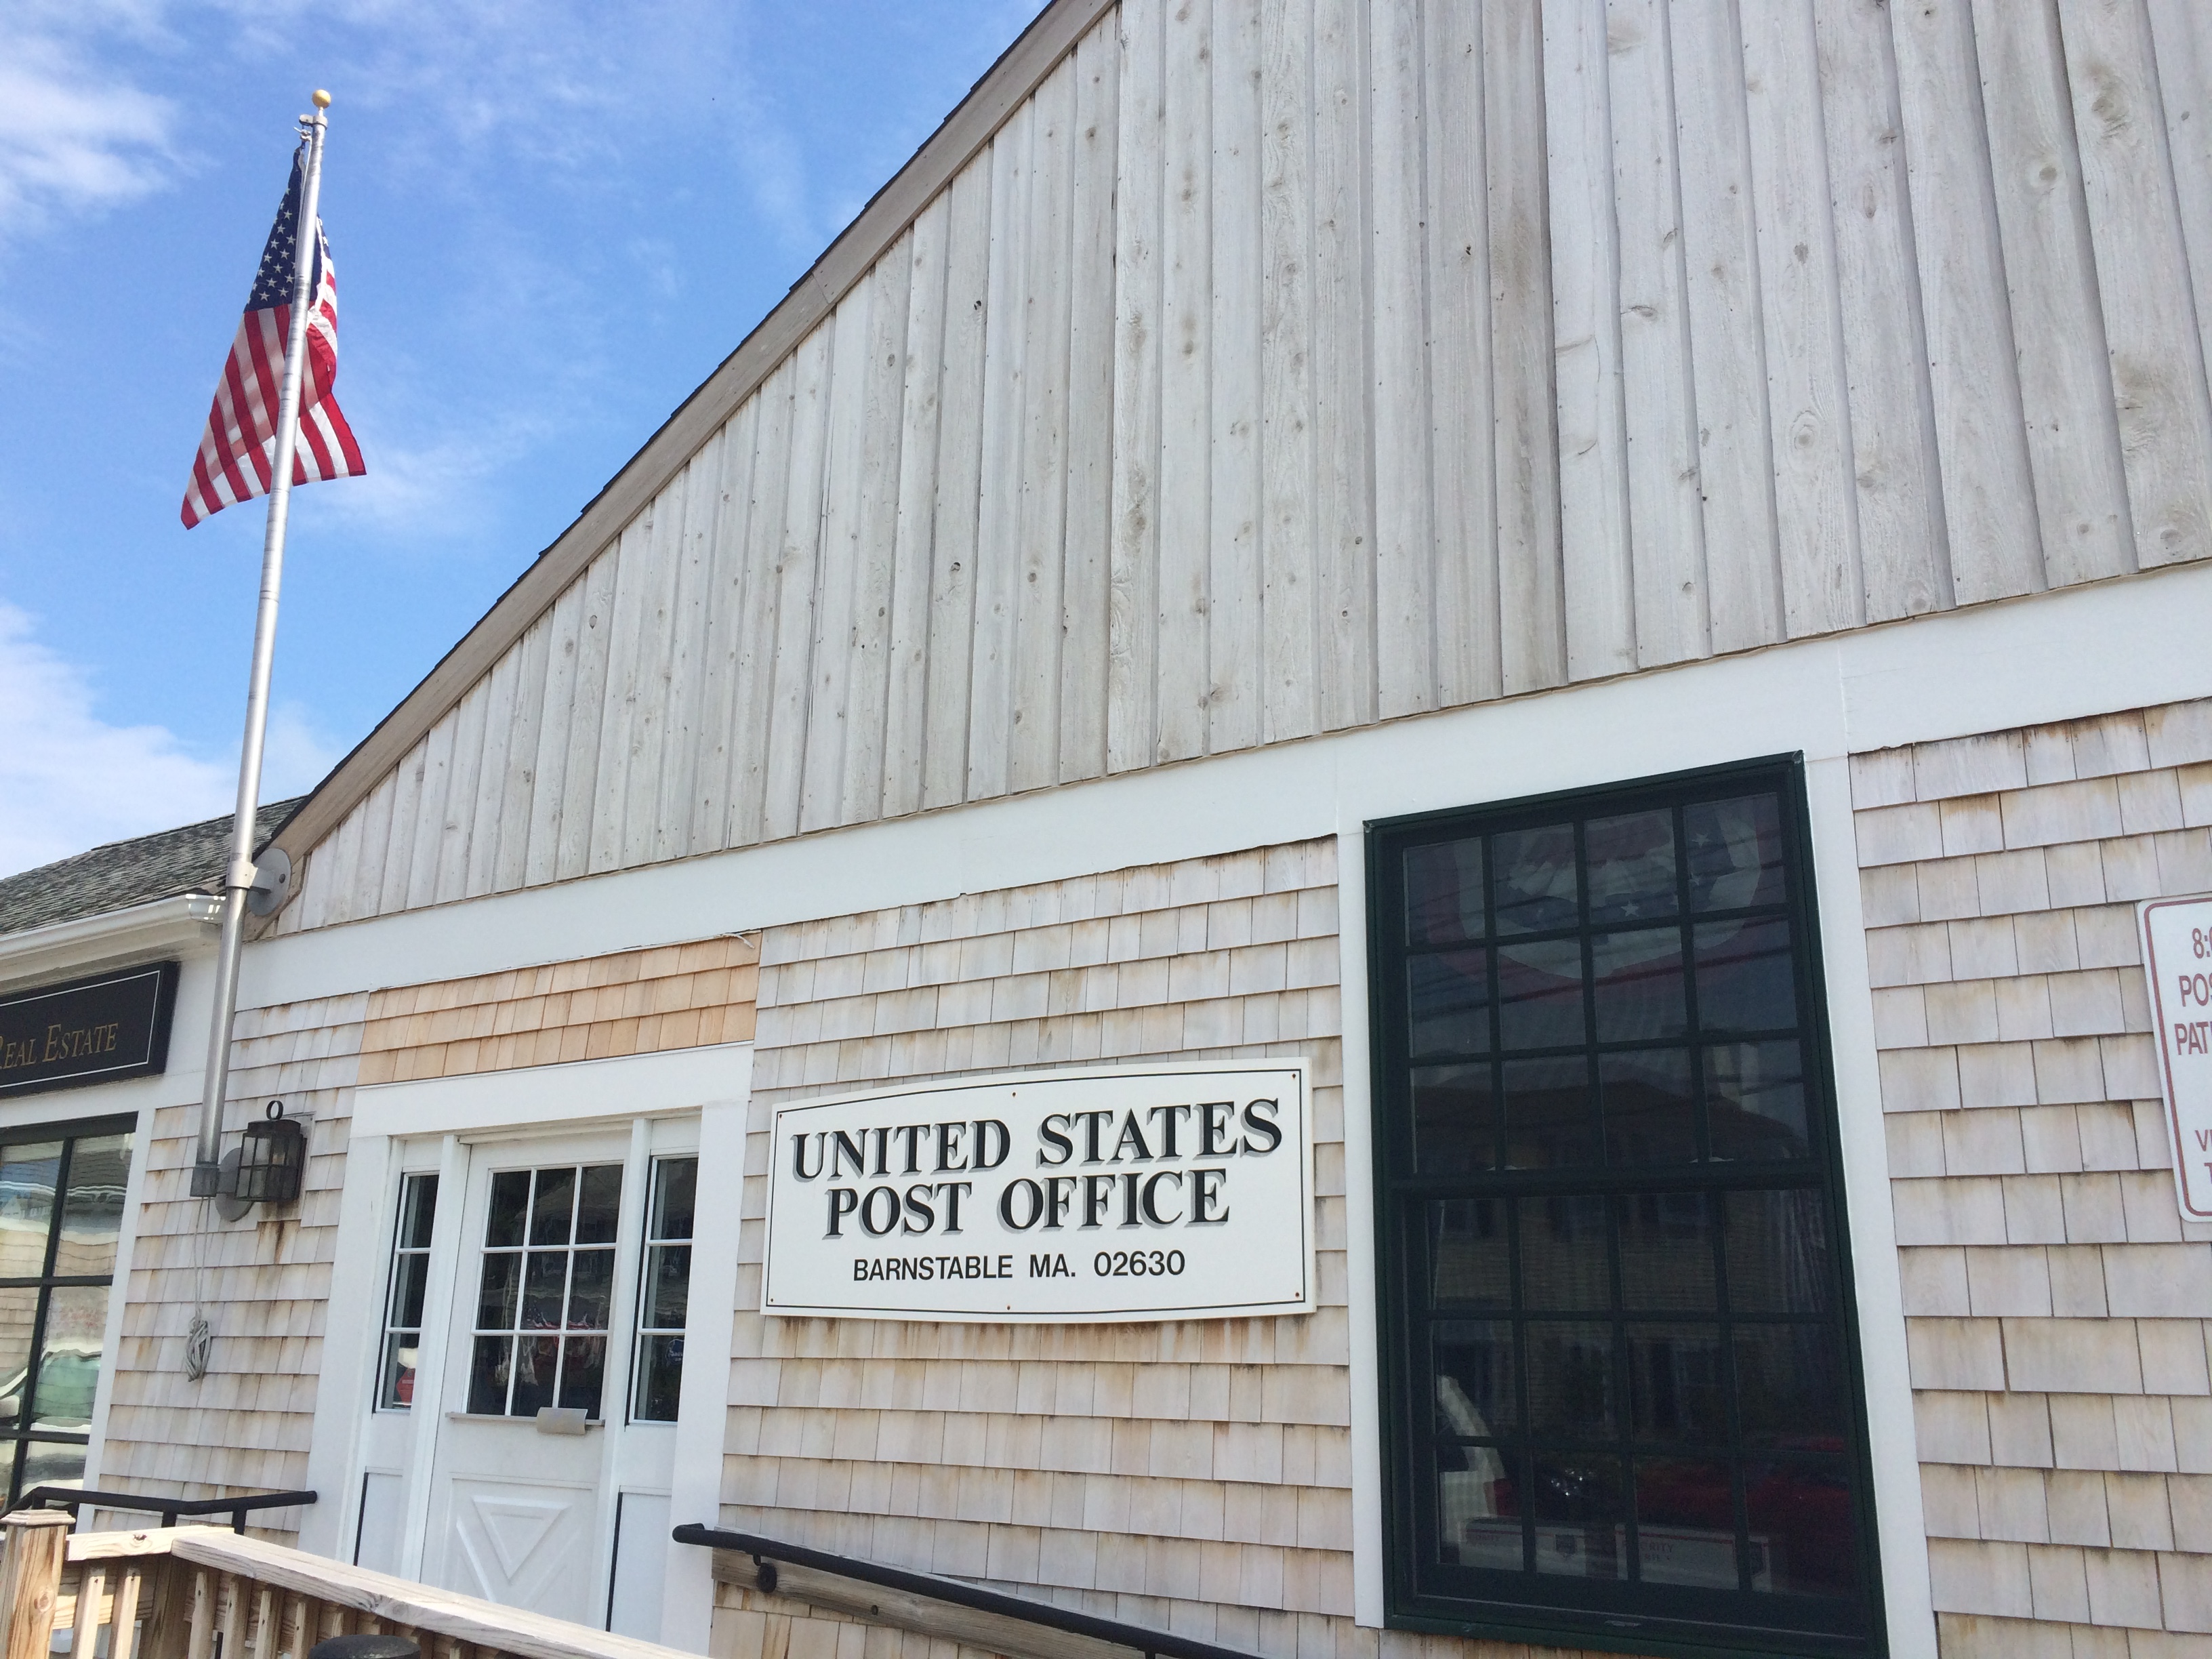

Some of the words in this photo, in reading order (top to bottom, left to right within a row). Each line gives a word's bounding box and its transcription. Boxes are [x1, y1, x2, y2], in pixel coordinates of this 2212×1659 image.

[2192, 926, 2212, 959] 8:
[2179, 973, 2212, 1007] PO
[42, 1023, 119, 1063] ESTATE
[2174, 1021, 2212, 1055] PAT
[791, 1120, 1010, 1183] UNITED
[1037, 1098, 1282, 1168] STATES
[823, 1182, 972, 1240] POST
[998, 1168, 1229, 1233] OFFICE
[853, 1254, 1013, 1282] BARNSTABLE
[1029, 1253, 1076, 1278] MA.
[1093, 1249, 1186, 1277] 02630
